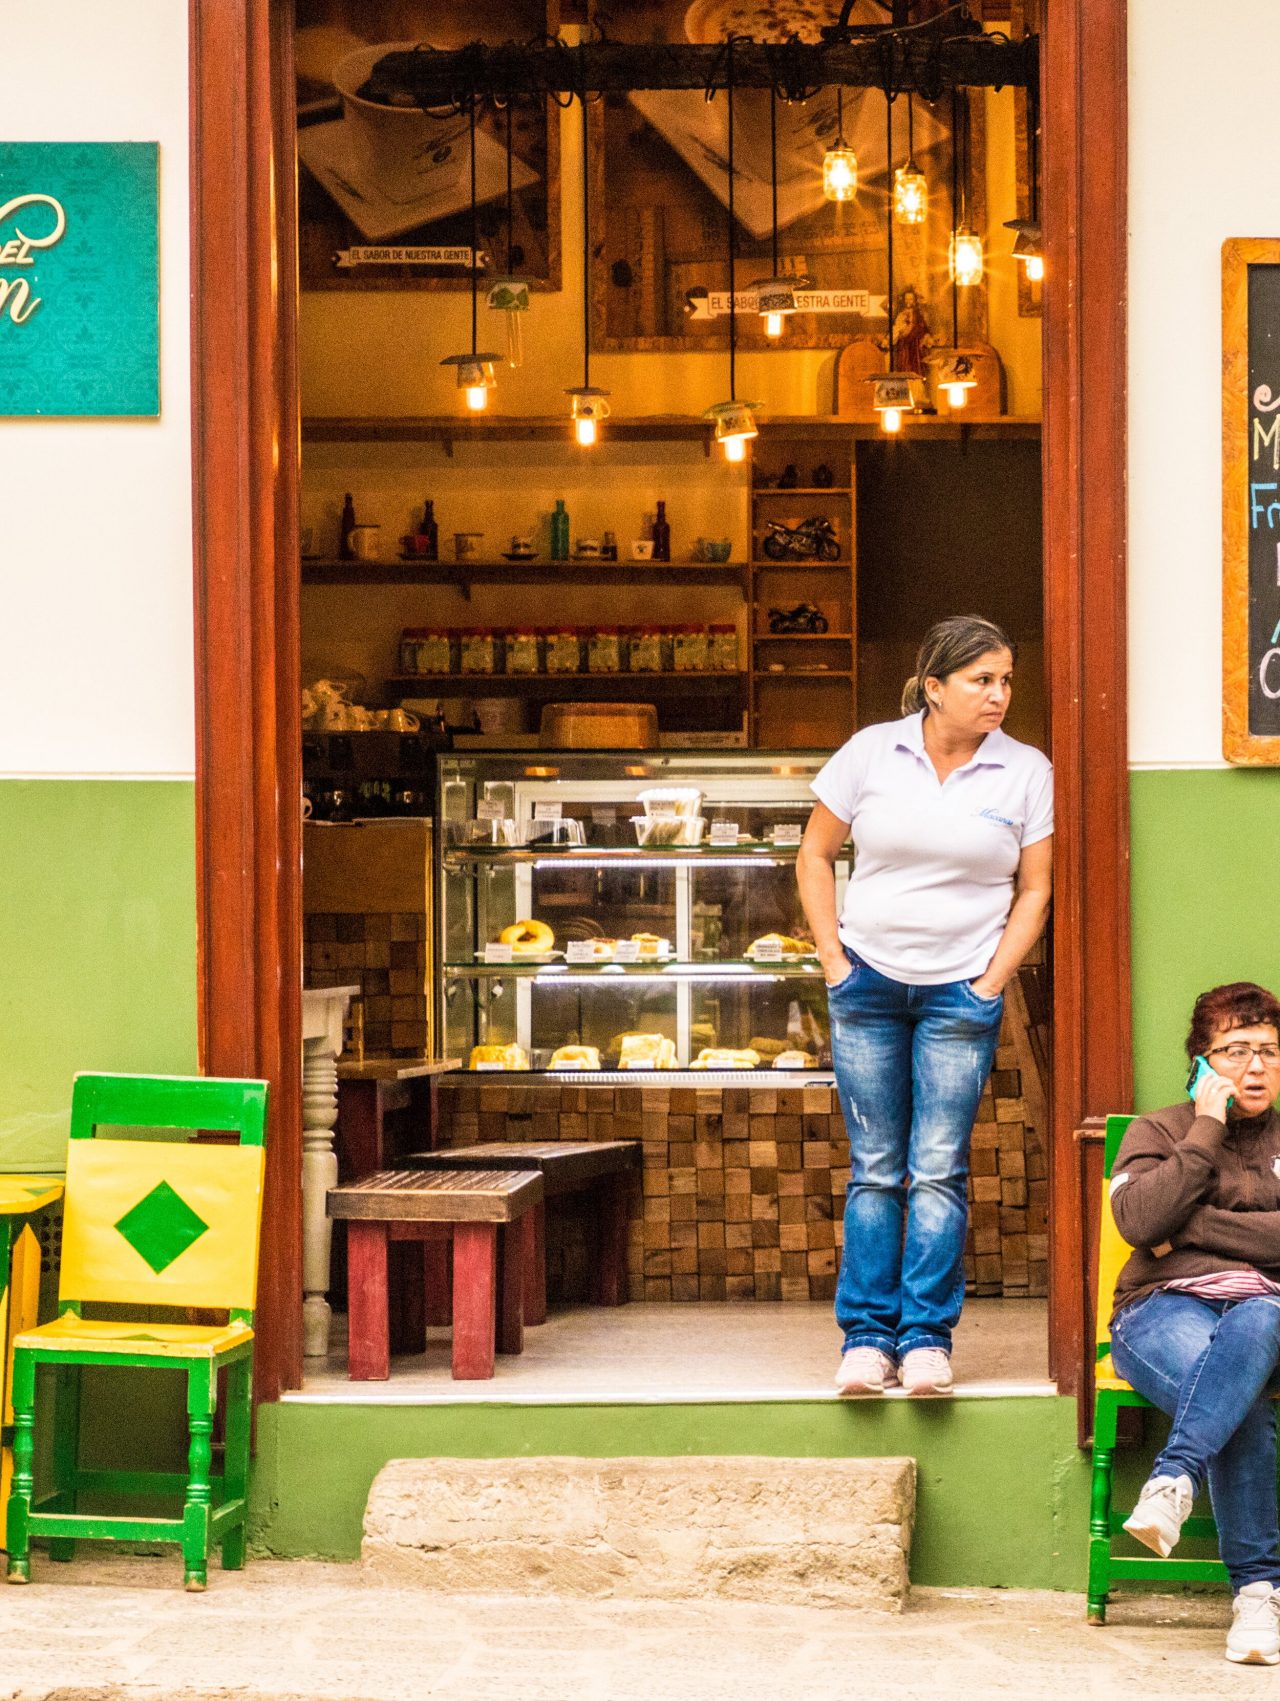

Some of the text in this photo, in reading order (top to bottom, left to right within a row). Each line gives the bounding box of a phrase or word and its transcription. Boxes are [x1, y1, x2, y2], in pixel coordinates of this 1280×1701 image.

[351, 249, 362, 260] EL
[391, 249, 403, 260] DE
[404, 249, 442, 260] NUESTRA
[443, 249, 470, 260] GENTE
[711, 296, 724, 310] EL
[832, 294, 867, 308] GENTE
